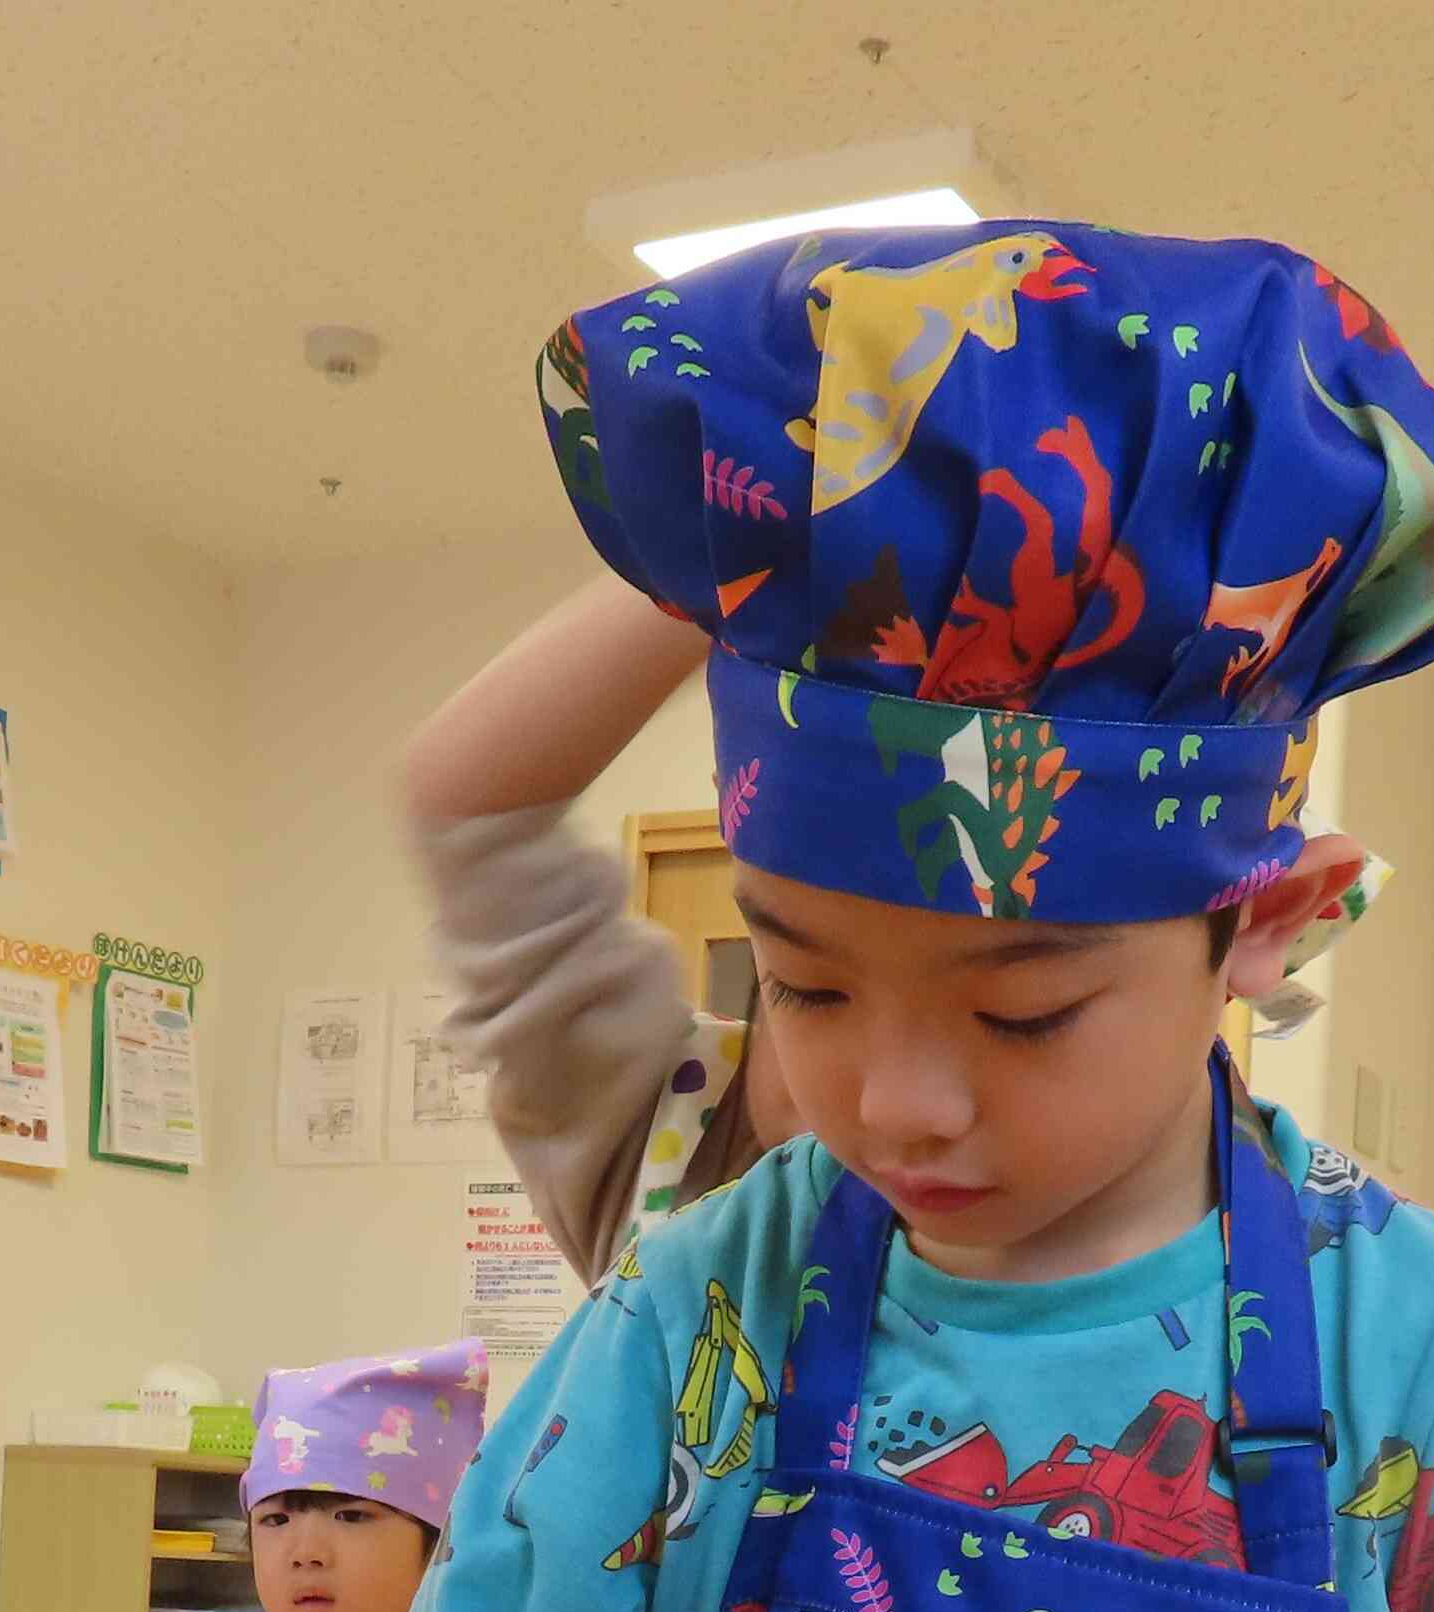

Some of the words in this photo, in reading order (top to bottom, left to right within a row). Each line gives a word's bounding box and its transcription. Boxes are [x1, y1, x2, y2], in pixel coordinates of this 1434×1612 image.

[94, 934, 203, 983] ほけんだより
